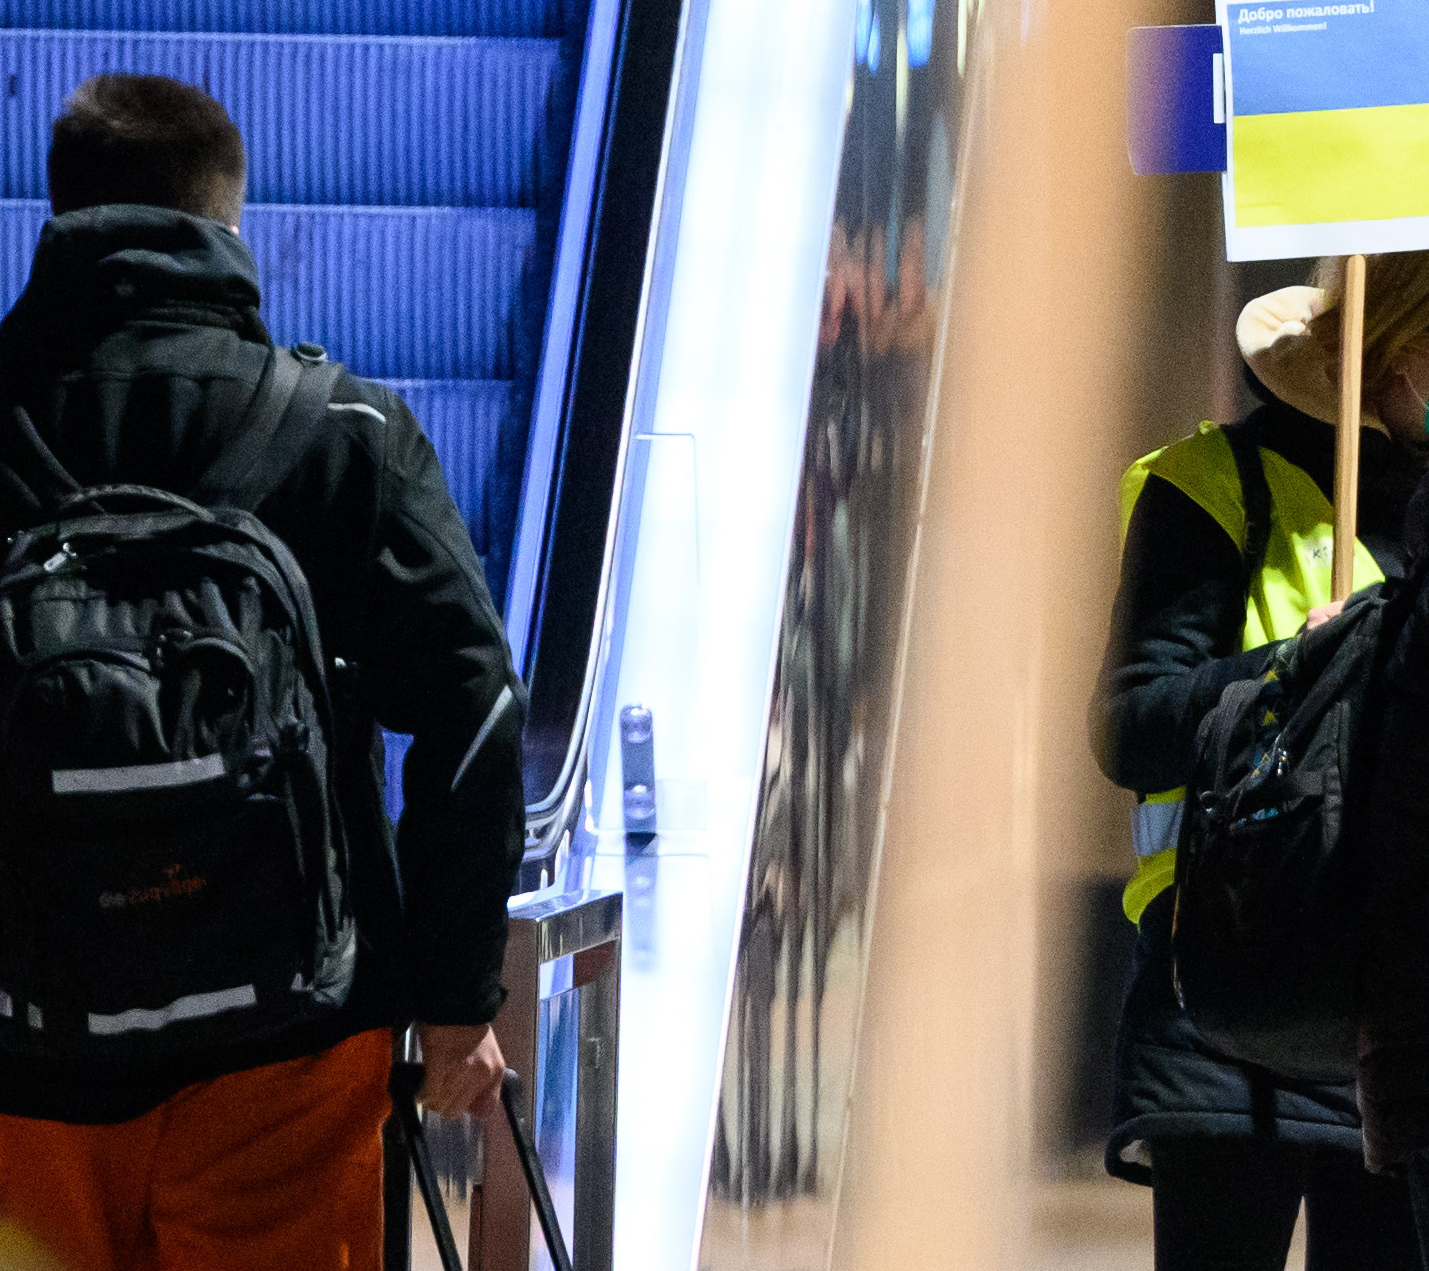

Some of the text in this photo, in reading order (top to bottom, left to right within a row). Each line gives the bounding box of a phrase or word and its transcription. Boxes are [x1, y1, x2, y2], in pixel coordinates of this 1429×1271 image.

[1238, 0, 1375, 24] Добро пожаловать!
[1239, 25, 1272, 36] Herzlich
